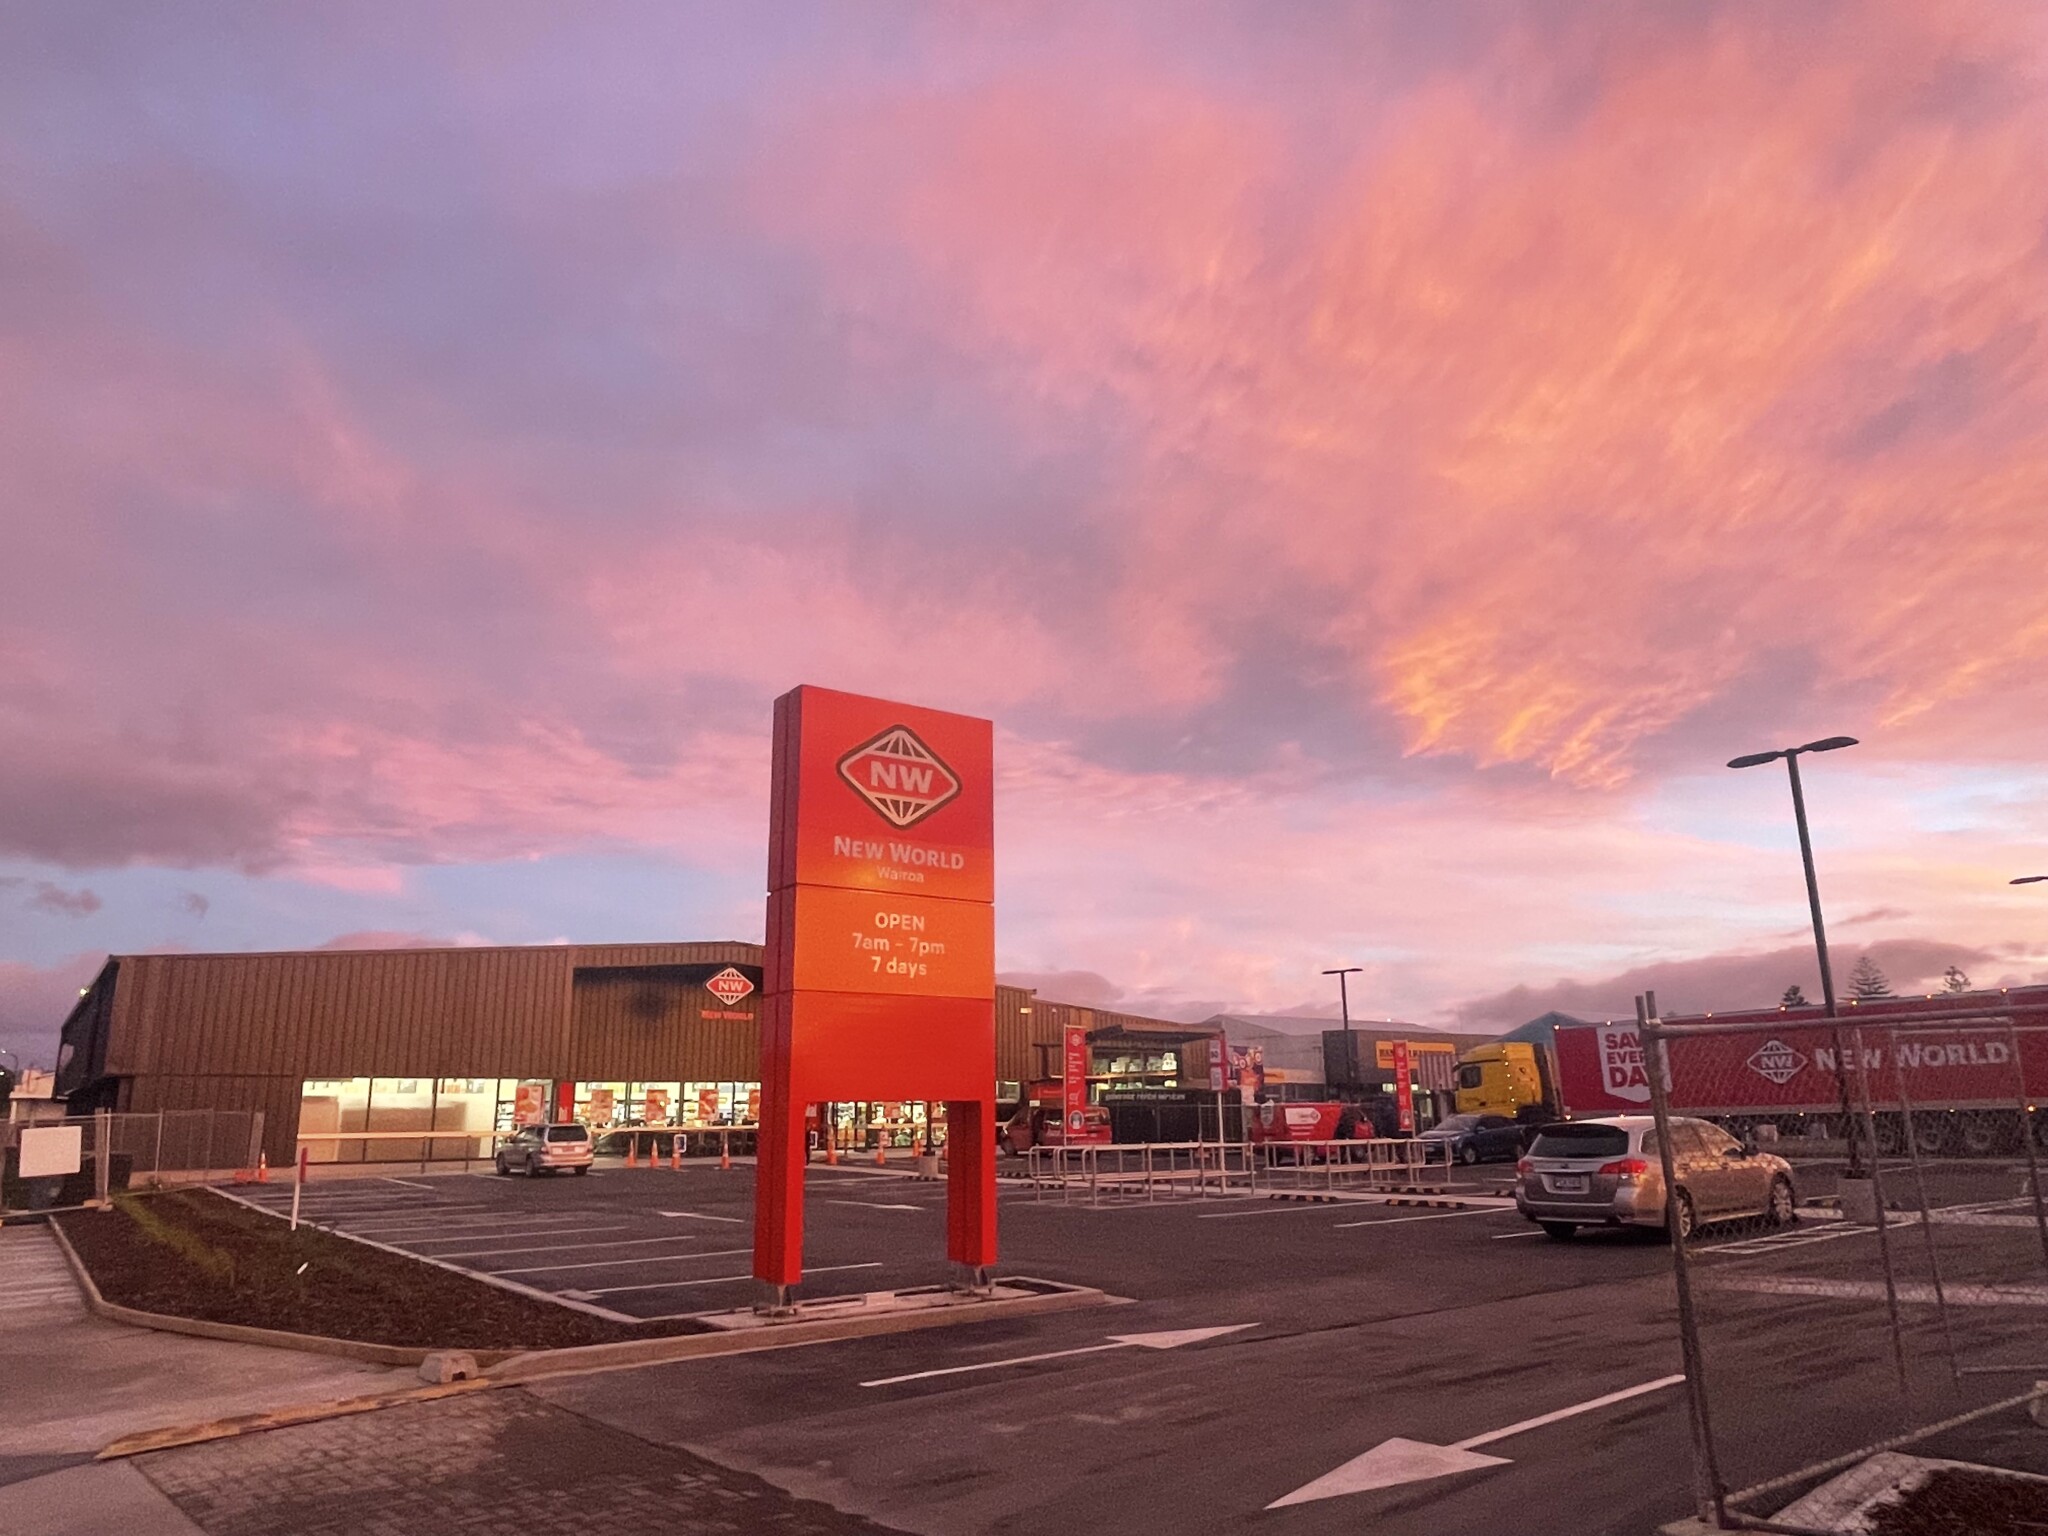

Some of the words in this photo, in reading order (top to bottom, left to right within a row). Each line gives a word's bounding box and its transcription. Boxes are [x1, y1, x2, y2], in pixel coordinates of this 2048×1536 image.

[870, 760, 934, 794] NW
[833, 835, 884, 860] NEW
[889, 842, 965, 869] WORLD
[877, 865, 925, 882] Wairoa
[874, 911, 925, 931] OPEN
[852, 932, 890, 951] 7am
[909, 936, 945, 957] 7pm
[871, 955, 882, 973] 7
[885, 956, 927, 979] days
[718, 980, 744, 992] NW
[1604, 1032, 1645, 1050] SAV
[1606, 1050, 1646, 1065] EVE
[1814, 1047, 1882, 1071] NEW
[1897, 1041, 2010, 1068] WORLD
[1608, 1065, 1650, 1088] DA
